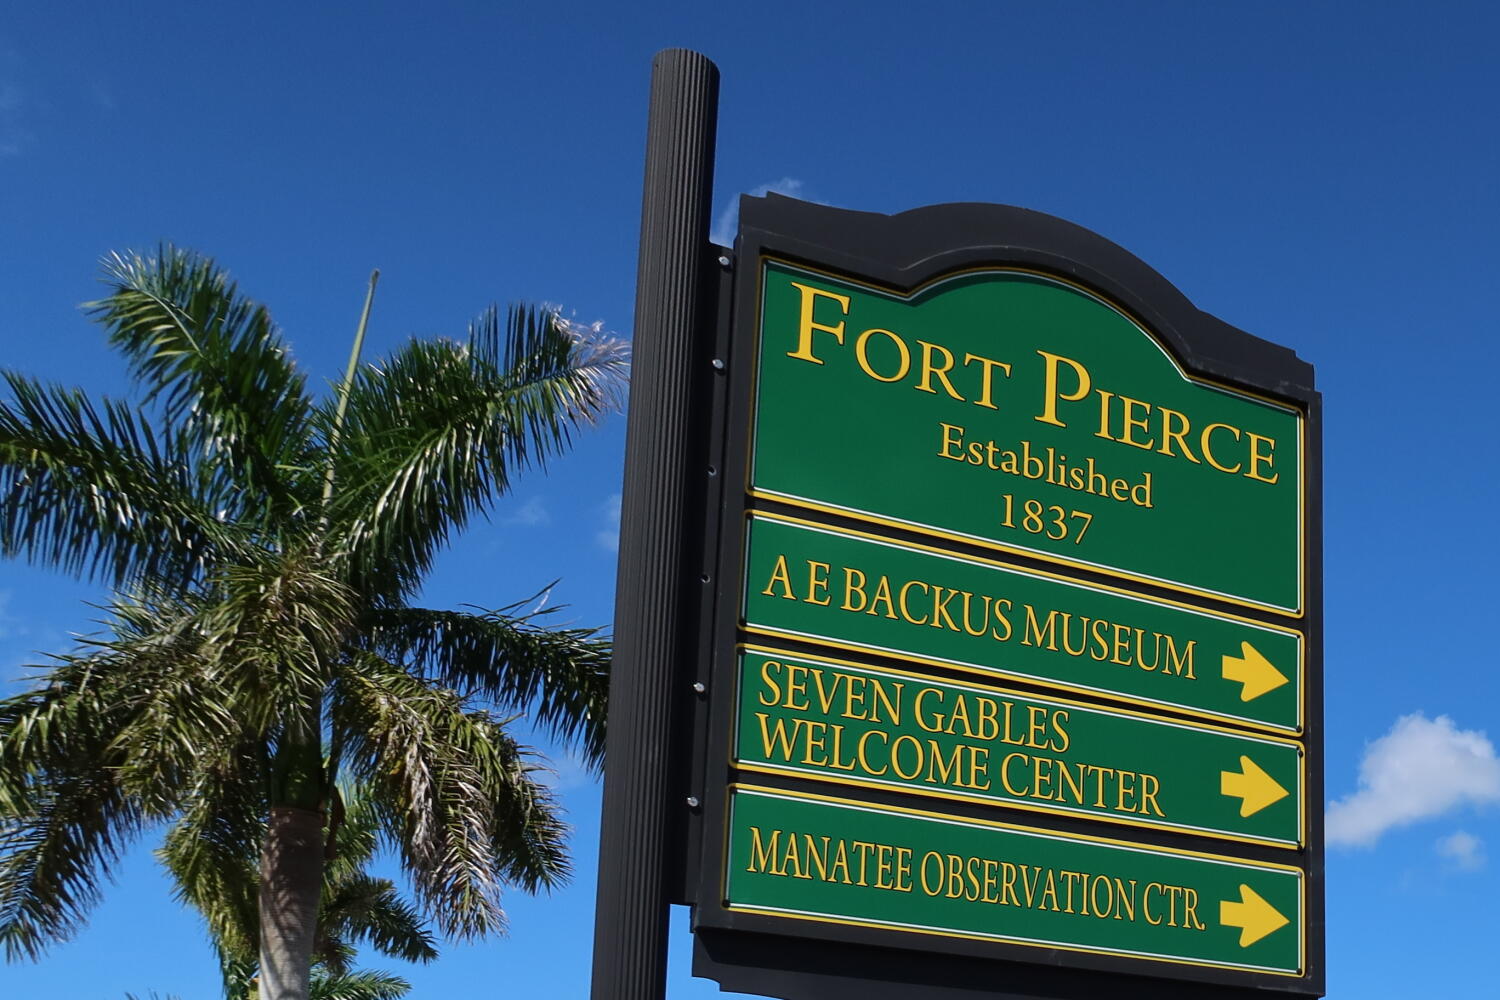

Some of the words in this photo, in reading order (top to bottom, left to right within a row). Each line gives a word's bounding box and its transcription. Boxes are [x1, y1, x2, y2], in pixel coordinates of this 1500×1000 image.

[787, 281, 1011, 410] FORT
[1034, 349, 1280, 484] PIERCE
[938, 422, 1154, 508] Established
[1000, 494, 1094, 545] 1837
[762, 555, 796, 600] A
[804, 561, 832, 606] E
[841, 567, 1014, 642] BACKUS
[1022, 604, 1198, 680] MUSEUM
[758, 660, 905, 727] SEVEN
[914, 687, 1071, 754] GABLES
[754, 713, 991, 792] WELCOME
[1001, 752, 1166, 817] CENTER
[746, 826, 914, 893] MANATEE
[919, 850, 1137, 923] OBSERVATION
